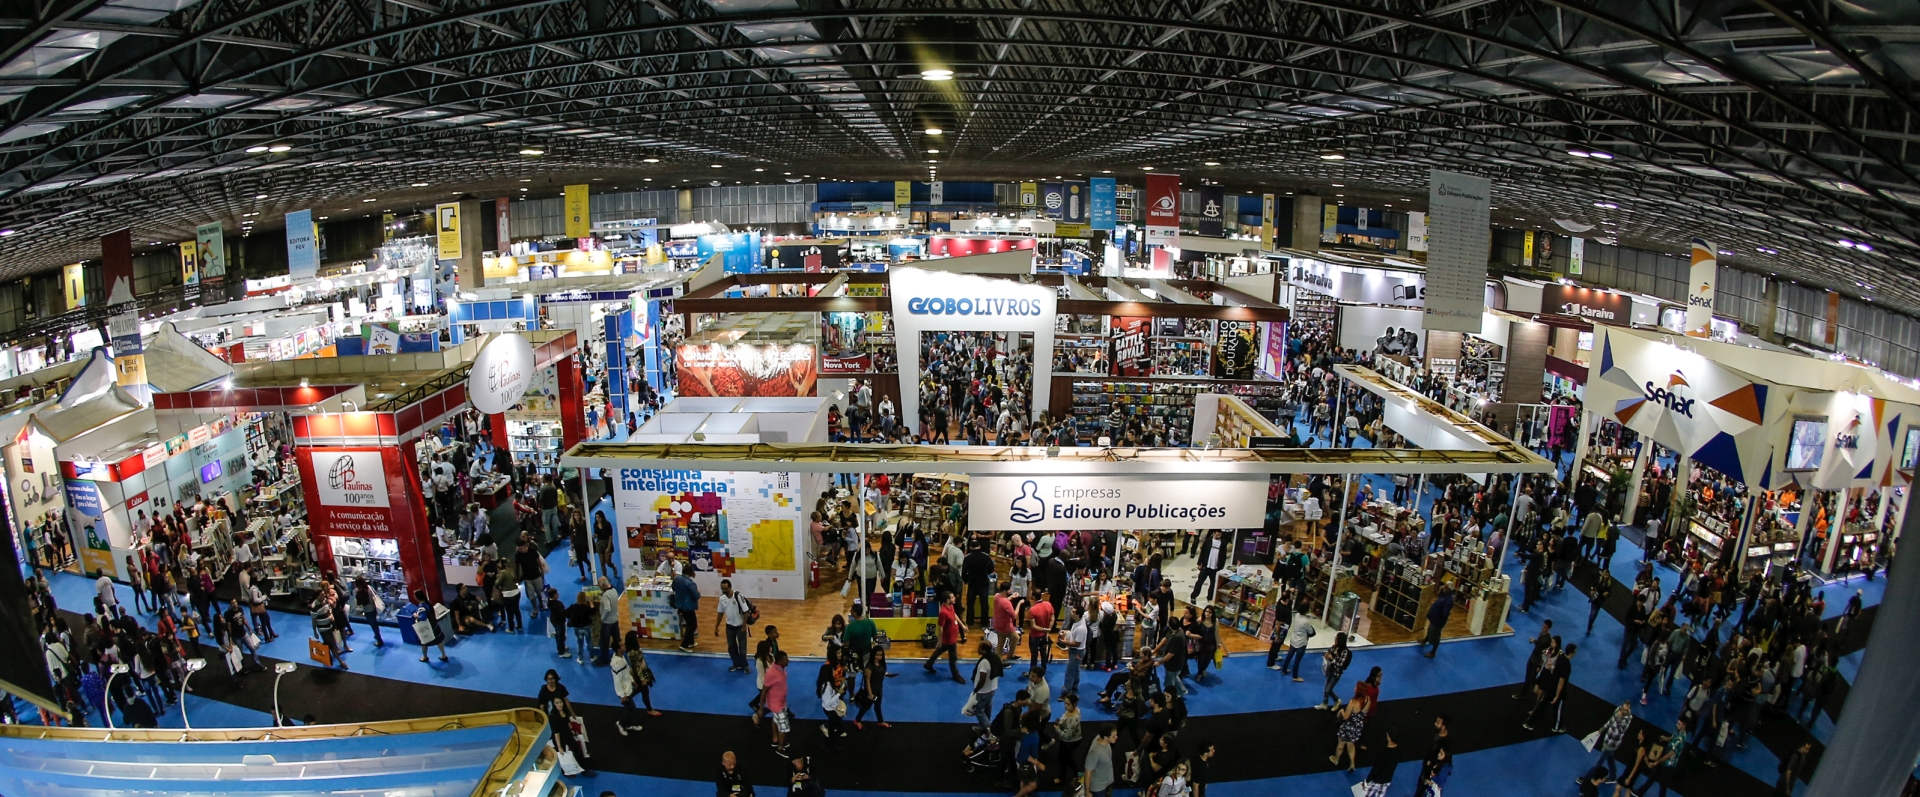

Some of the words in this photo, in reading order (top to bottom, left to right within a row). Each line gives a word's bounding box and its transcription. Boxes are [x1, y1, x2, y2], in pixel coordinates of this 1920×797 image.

[290, 236, 310, 244] EDITORA
[184, 254, 195, 274] H
[1304, 269, 1333, 290] Saraiva
[1689, 294, 1712, 309] Senac
[1432, 308, 1466, 318] HarperCollins
[1580, 306, 1614, 320] Saraiva
[1115, 332, 1144, 352] BATTLE
[1226, 321, 1238, 375] DOURADO
[1116, 343, 1145, 363] ROYALE
[501, 388, 512, 404] 100
[1644, 381, 1694, 419] Senac
[343, 470, 372, 490] Paulinas
[620, 468, 702, 480] consuma
[621, 478, 728, 494] inteligência
[1054, 486, 1121, 501] Empresas
[132, 497, 142, 506] Caixa
[344, 493, 360, 504] 100
[330, 510, 336, 518] A
[336, 511, 384, 522] comunicação
[1053, 504, 1122, 519] Ediouro
[1126, 504, 1226, 522] Publicações
[336, 521, 360, 532] serviço
[362, 522, 372, 530] da
[372, 522, 389, 531] vida
